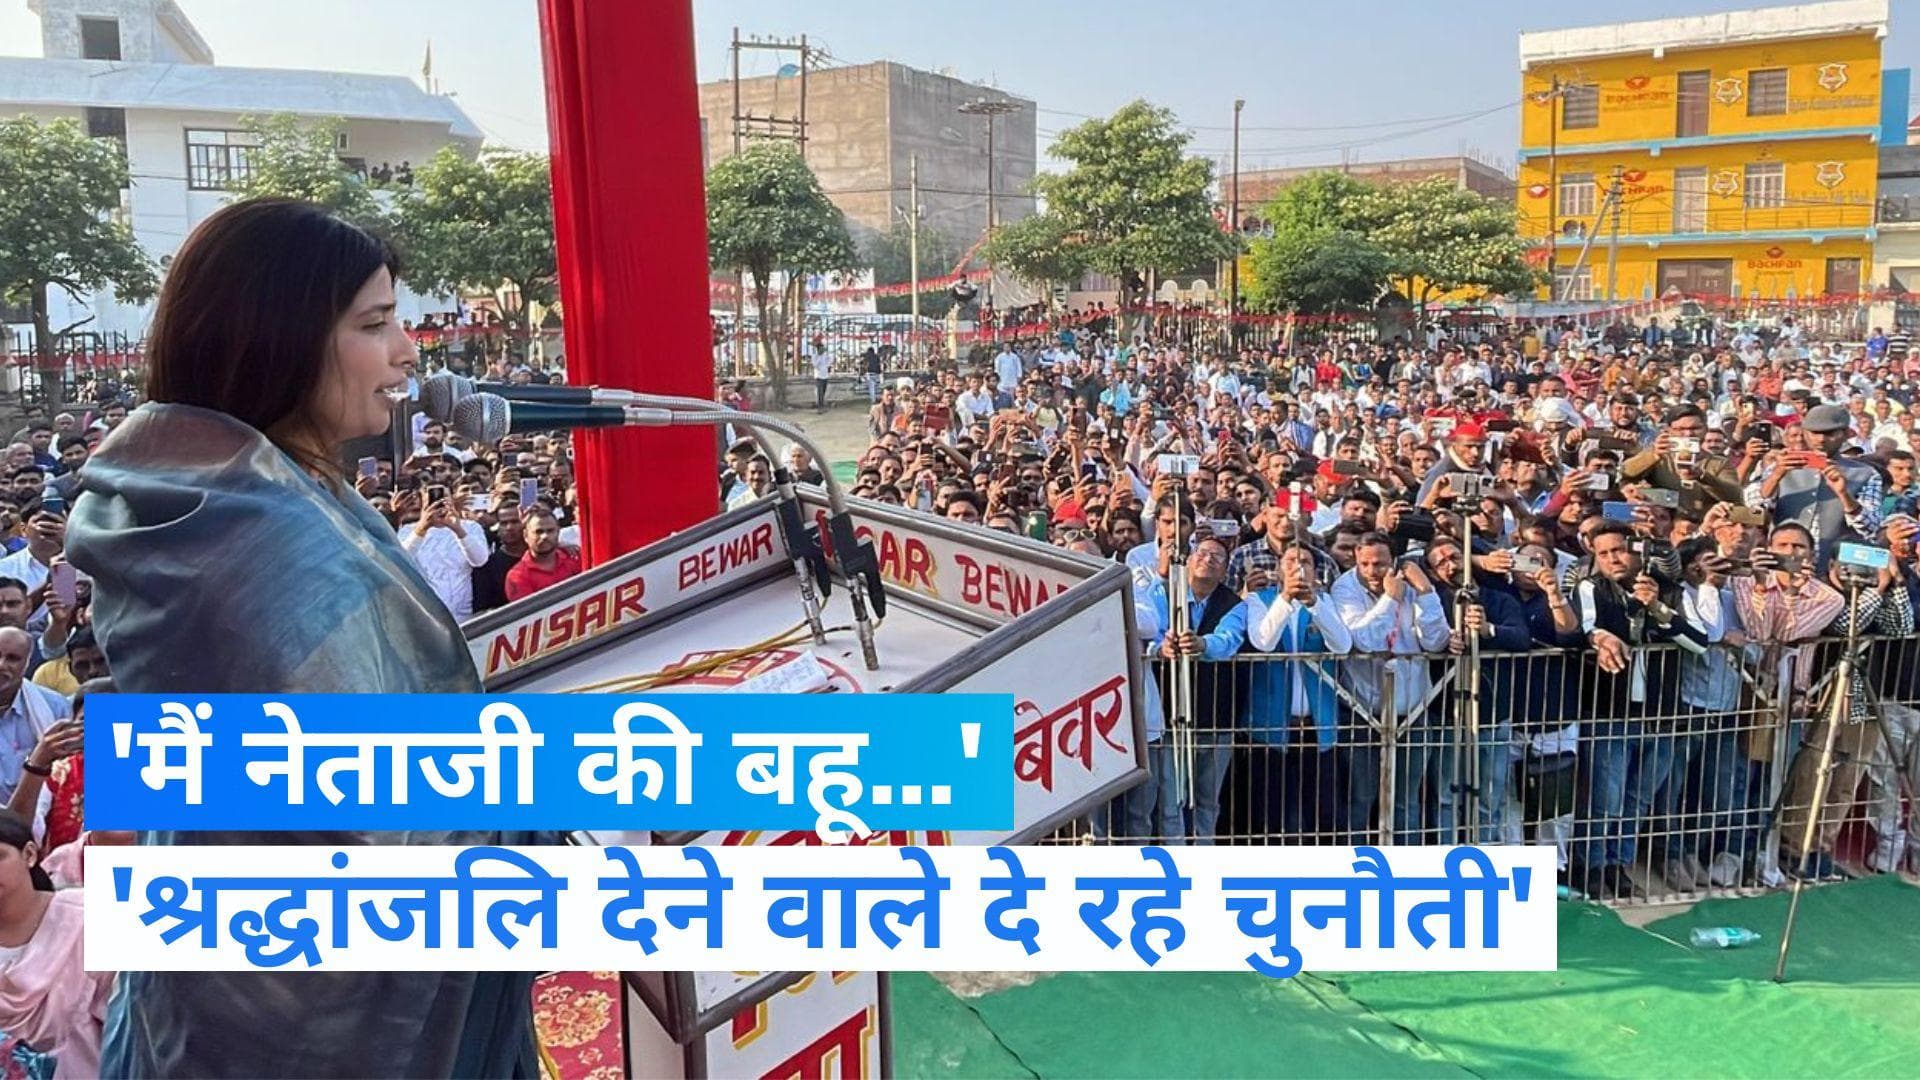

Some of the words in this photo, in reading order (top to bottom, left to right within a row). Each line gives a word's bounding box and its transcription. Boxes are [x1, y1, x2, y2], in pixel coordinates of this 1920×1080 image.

[484, 576, 649, 677] NISAR
[678, 522, 773, 592] BEWAR
[954, 554, 1069, 618] BEWA
[1014, 675, 1128, 793] बेवर
